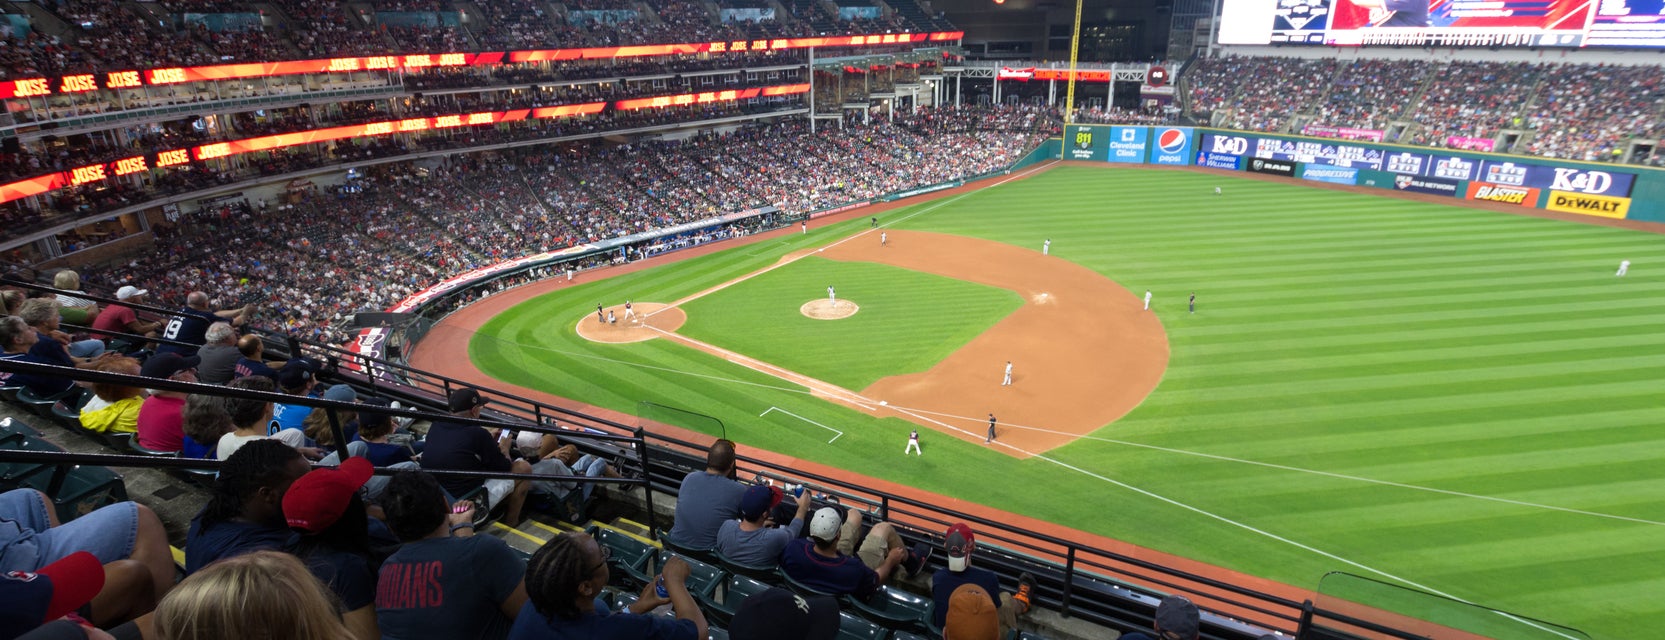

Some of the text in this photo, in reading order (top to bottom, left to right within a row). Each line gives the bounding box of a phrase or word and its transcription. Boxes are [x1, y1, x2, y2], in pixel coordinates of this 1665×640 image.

[709, 39, 787, 52] JOSE JOSE JOSE JOSE
[329, 53, 465, 71] JOSE JOSE JOSE JOSE
[14, 68, 186, 97] JOSE JOSE JOSE JOSE
[364, 112, 493, 136] JOSE JOSE JOSE JOSE
[1076, 132, 1092, 144] 811
[1110, 142, 1145, 150] Cleveland
[1211, 135, 1248, 155] K&D
[72, 142, 230, 185] JOSE JOSE JOSE JOSE
[1208, 152, 1237, 162] SHERWIN
[1264, 163, 1291, 171] RAM
[1303, 169, 1358, 179] PROGRESSIVE
[1425, 182, 1456, 191] NETWORK
[1549, 168, 1612, 194] K&D
[1474, 186, 1528, 204] BLASTER
[163, 319, 183, 340] 19
[376, 560, 443, 609] NDIANS
